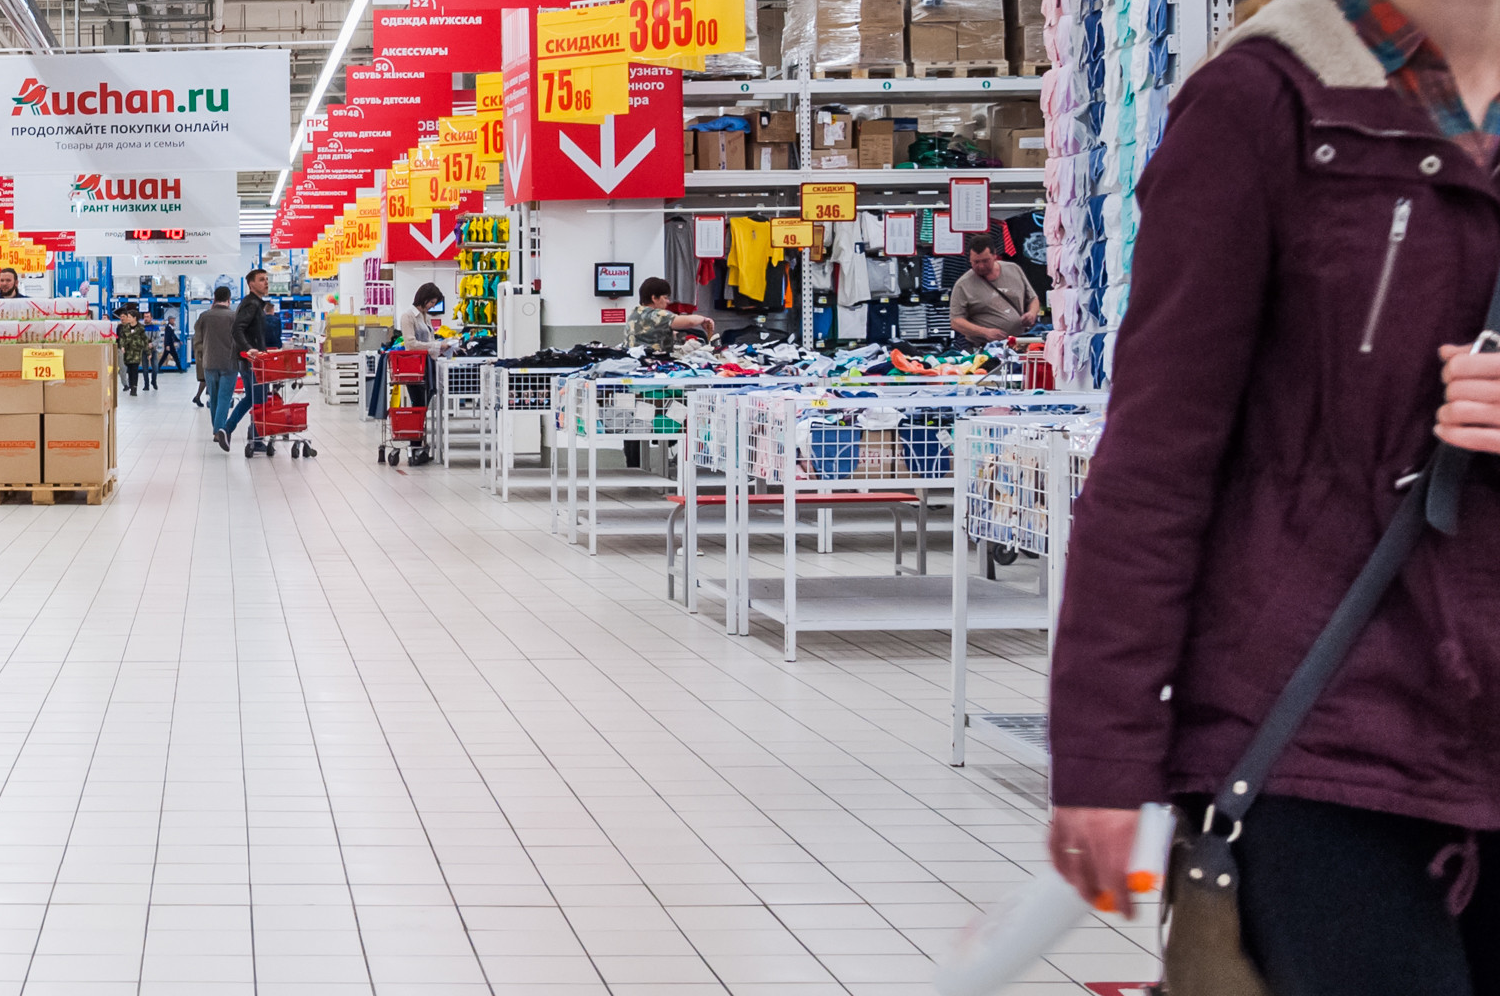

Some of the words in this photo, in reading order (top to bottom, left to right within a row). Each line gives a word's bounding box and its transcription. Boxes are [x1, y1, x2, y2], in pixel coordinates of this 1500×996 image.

[381, 16, 427, 27] ОДЕЖДА
[429, 15, 482, 26] МУЖСКАЯ
[545, 33, 620, 53] СКИДКИ!
[382, 46, 448, 56] АКСЕССУАРЫ
[375, 63, 389, 71] 50
[383, 71, 425, 79] ЖЕНСКАЯ
[11, 78, 229, 116] Auchan.ru
[353, 97, 381, 105] ОБУВЬ
[383, 96, 421, 105] ДЕТСКАЯ
[347, 110, 359, 118] 48
[11, 121, 107, 137] ПРОДОЛЖАЙТЕ
[111, 123, 171, 135] ПОКУПКИ
[175, 120, 229, 134] ОНЛАЙН
[359, 130, 391, 138] ДЕТСКАЯ
[55, 141, 93, 151] Товары
[95, 141, 114, 151] для
[116, 141, 142, 150] дома
[154, 140, 185, 149] семьи
[112, 204, 158, 213] НИЗКИХ
[160, 203, 181, 214] ЦЕН
[816, 204, 840, 218] 346
[783, 235, 797, 245] 49
[34, 367, 51, 377] 129
